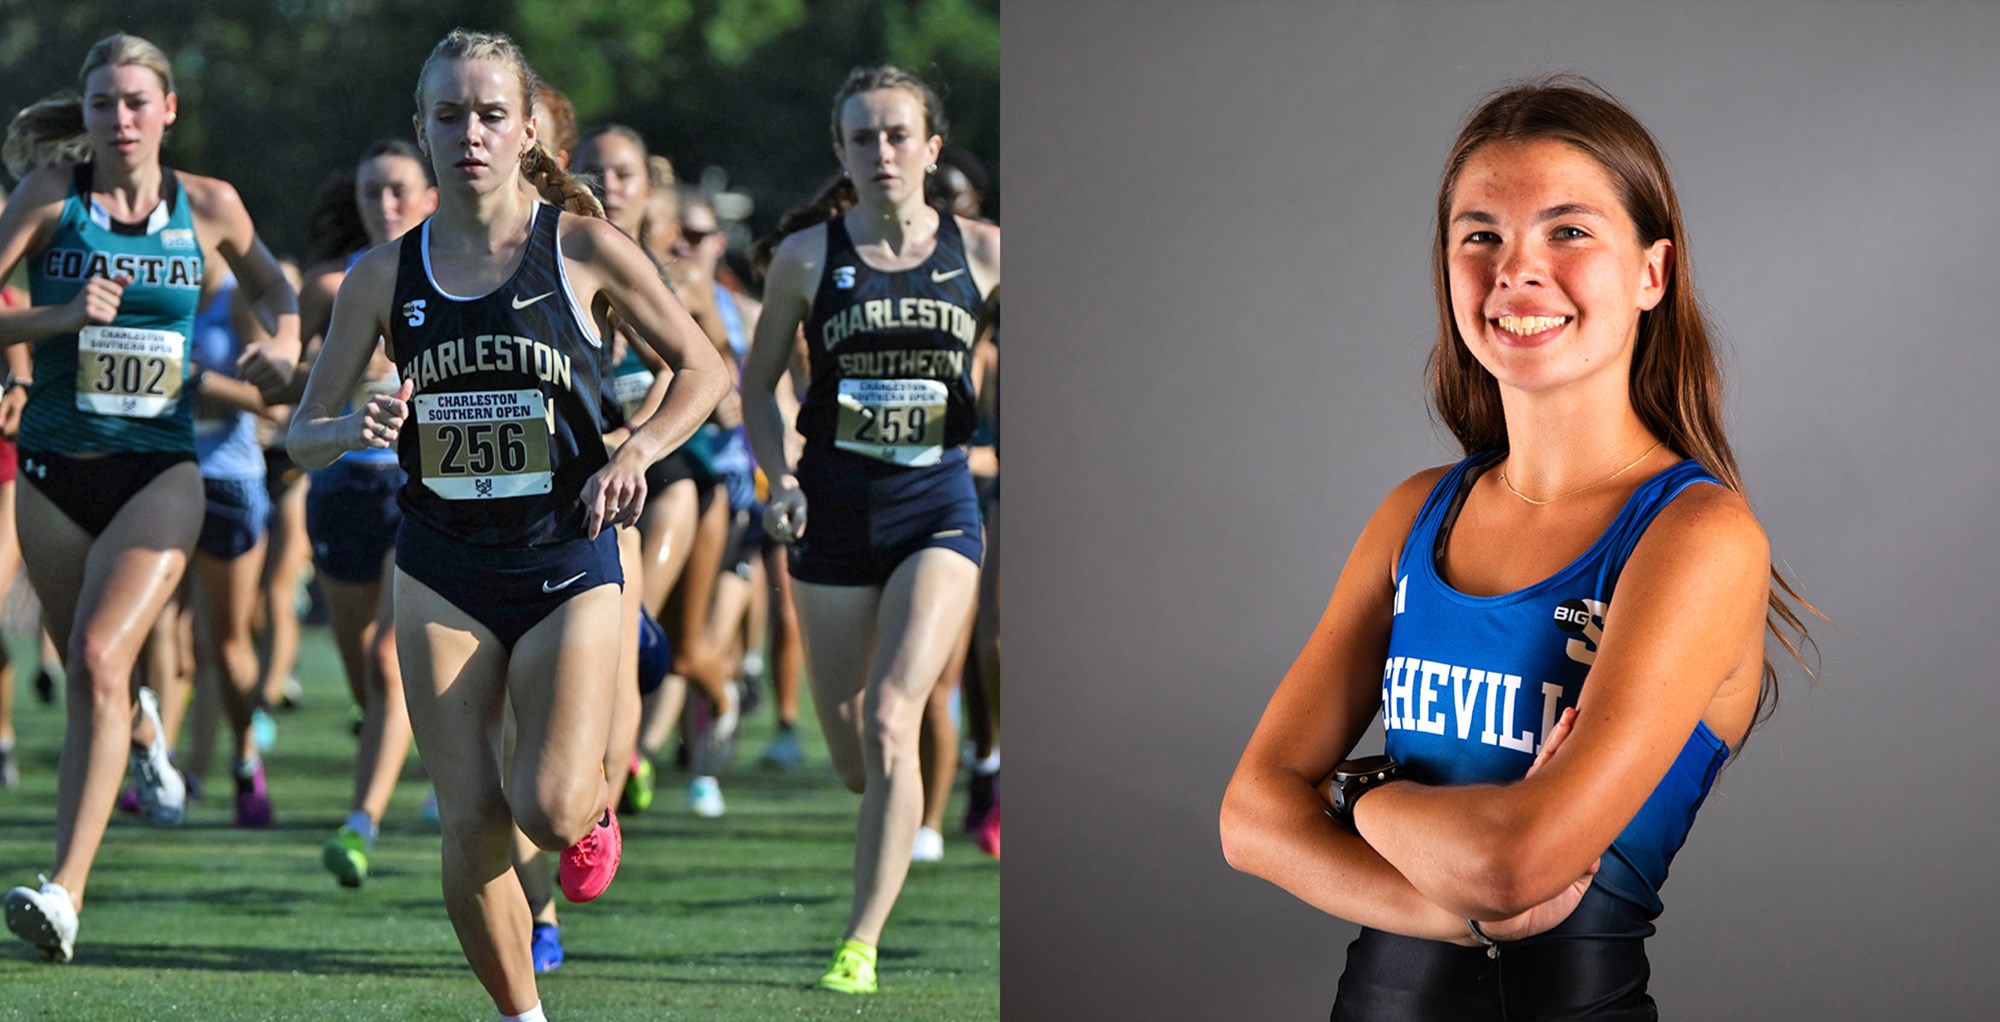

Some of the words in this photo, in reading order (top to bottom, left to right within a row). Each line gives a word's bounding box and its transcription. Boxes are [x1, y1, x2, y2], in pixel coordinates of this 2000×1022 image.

[823, 298, 977, 350] CHARLESTON
[96, 353, 166, 396] 302
[838, 350, 964, 378] SOUTHERN
[428, 408, 493, 421] SOUTHERN
[496, 405, 531, 418] OPEN
[437, 393, 518, 408] CHARLESTON
[855, 405, 926, 444] 259
[437, 422, 527, 476] 256
[1554, 606, 1589, 626] BIG
